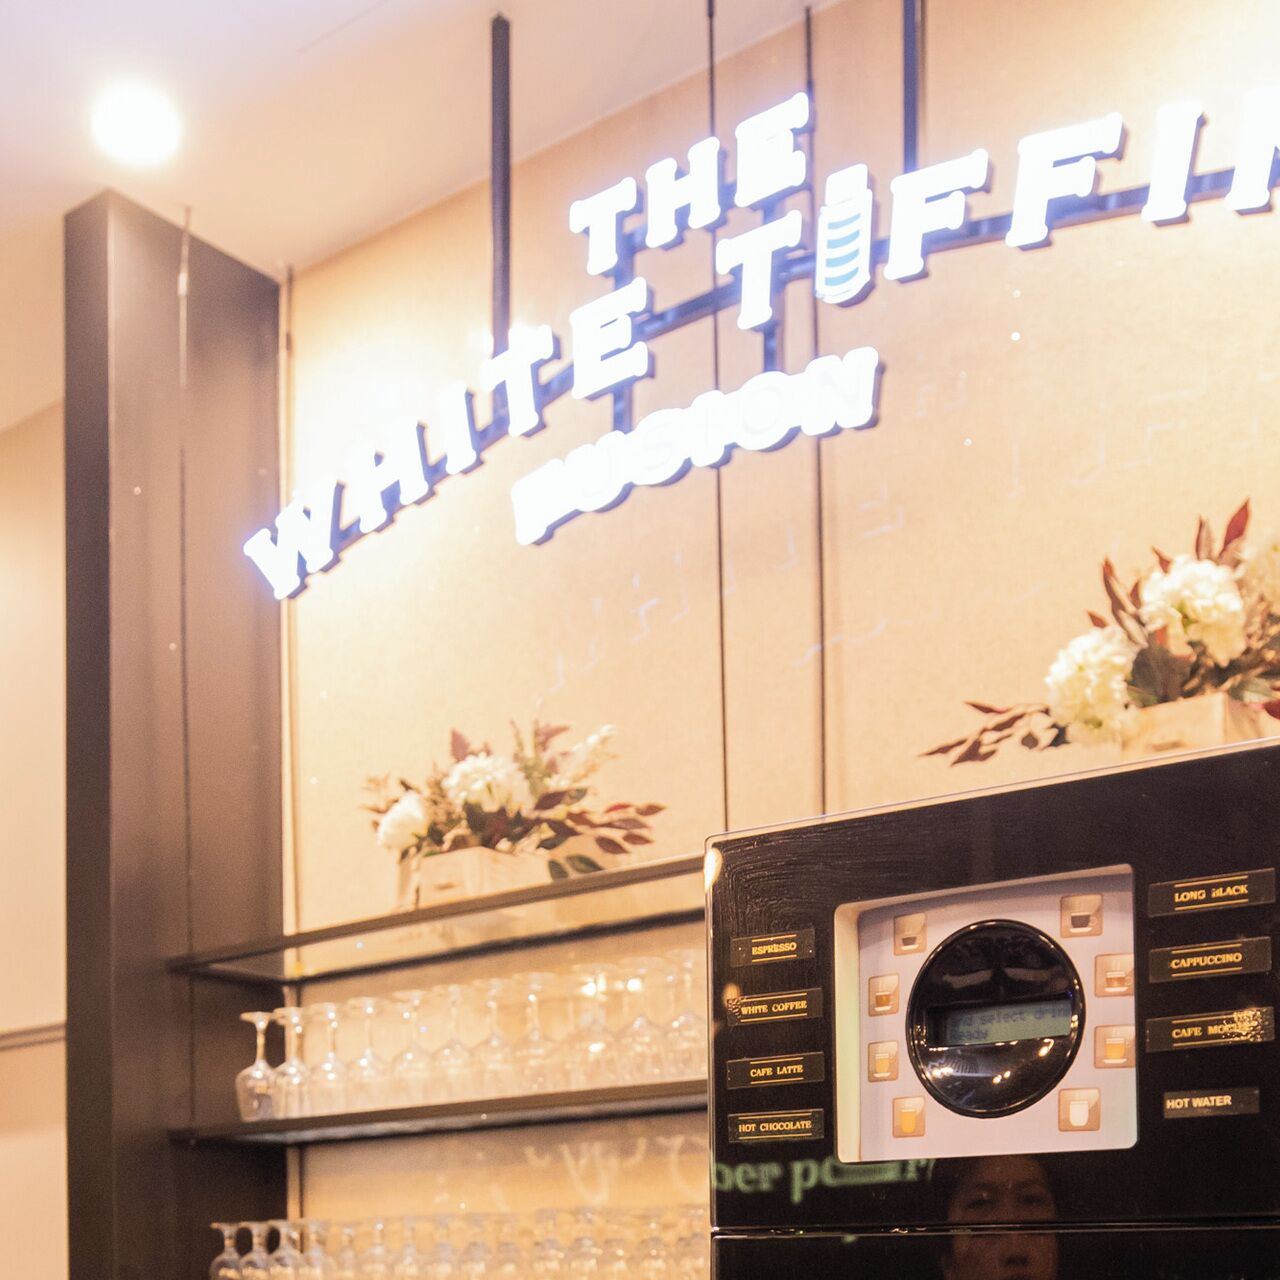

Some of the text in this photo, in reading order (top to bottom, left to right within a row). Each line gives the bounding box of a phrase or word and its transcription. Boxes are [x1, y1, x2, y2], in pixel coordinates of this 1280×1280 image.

[570, 92, 810, 276] THE
[243, 276, 650, 601] WHITE
[1174, 889, 1207, 904] LONG
[751, 940, 798, 956] ESPRESSO
[1170, 951, 1243, 970] CAPPUCCINO
[740, 998, 808, 1016] WHITE COFFEE
[1171, 1026, 1203, 1039] CAFE
[749, 1063, 804, 1079] CAFE LATTE
[1166, 1094, 1232, 1111] HOT WATER
[738, 1119, 812, 1134] HOT CHOCOLATE
